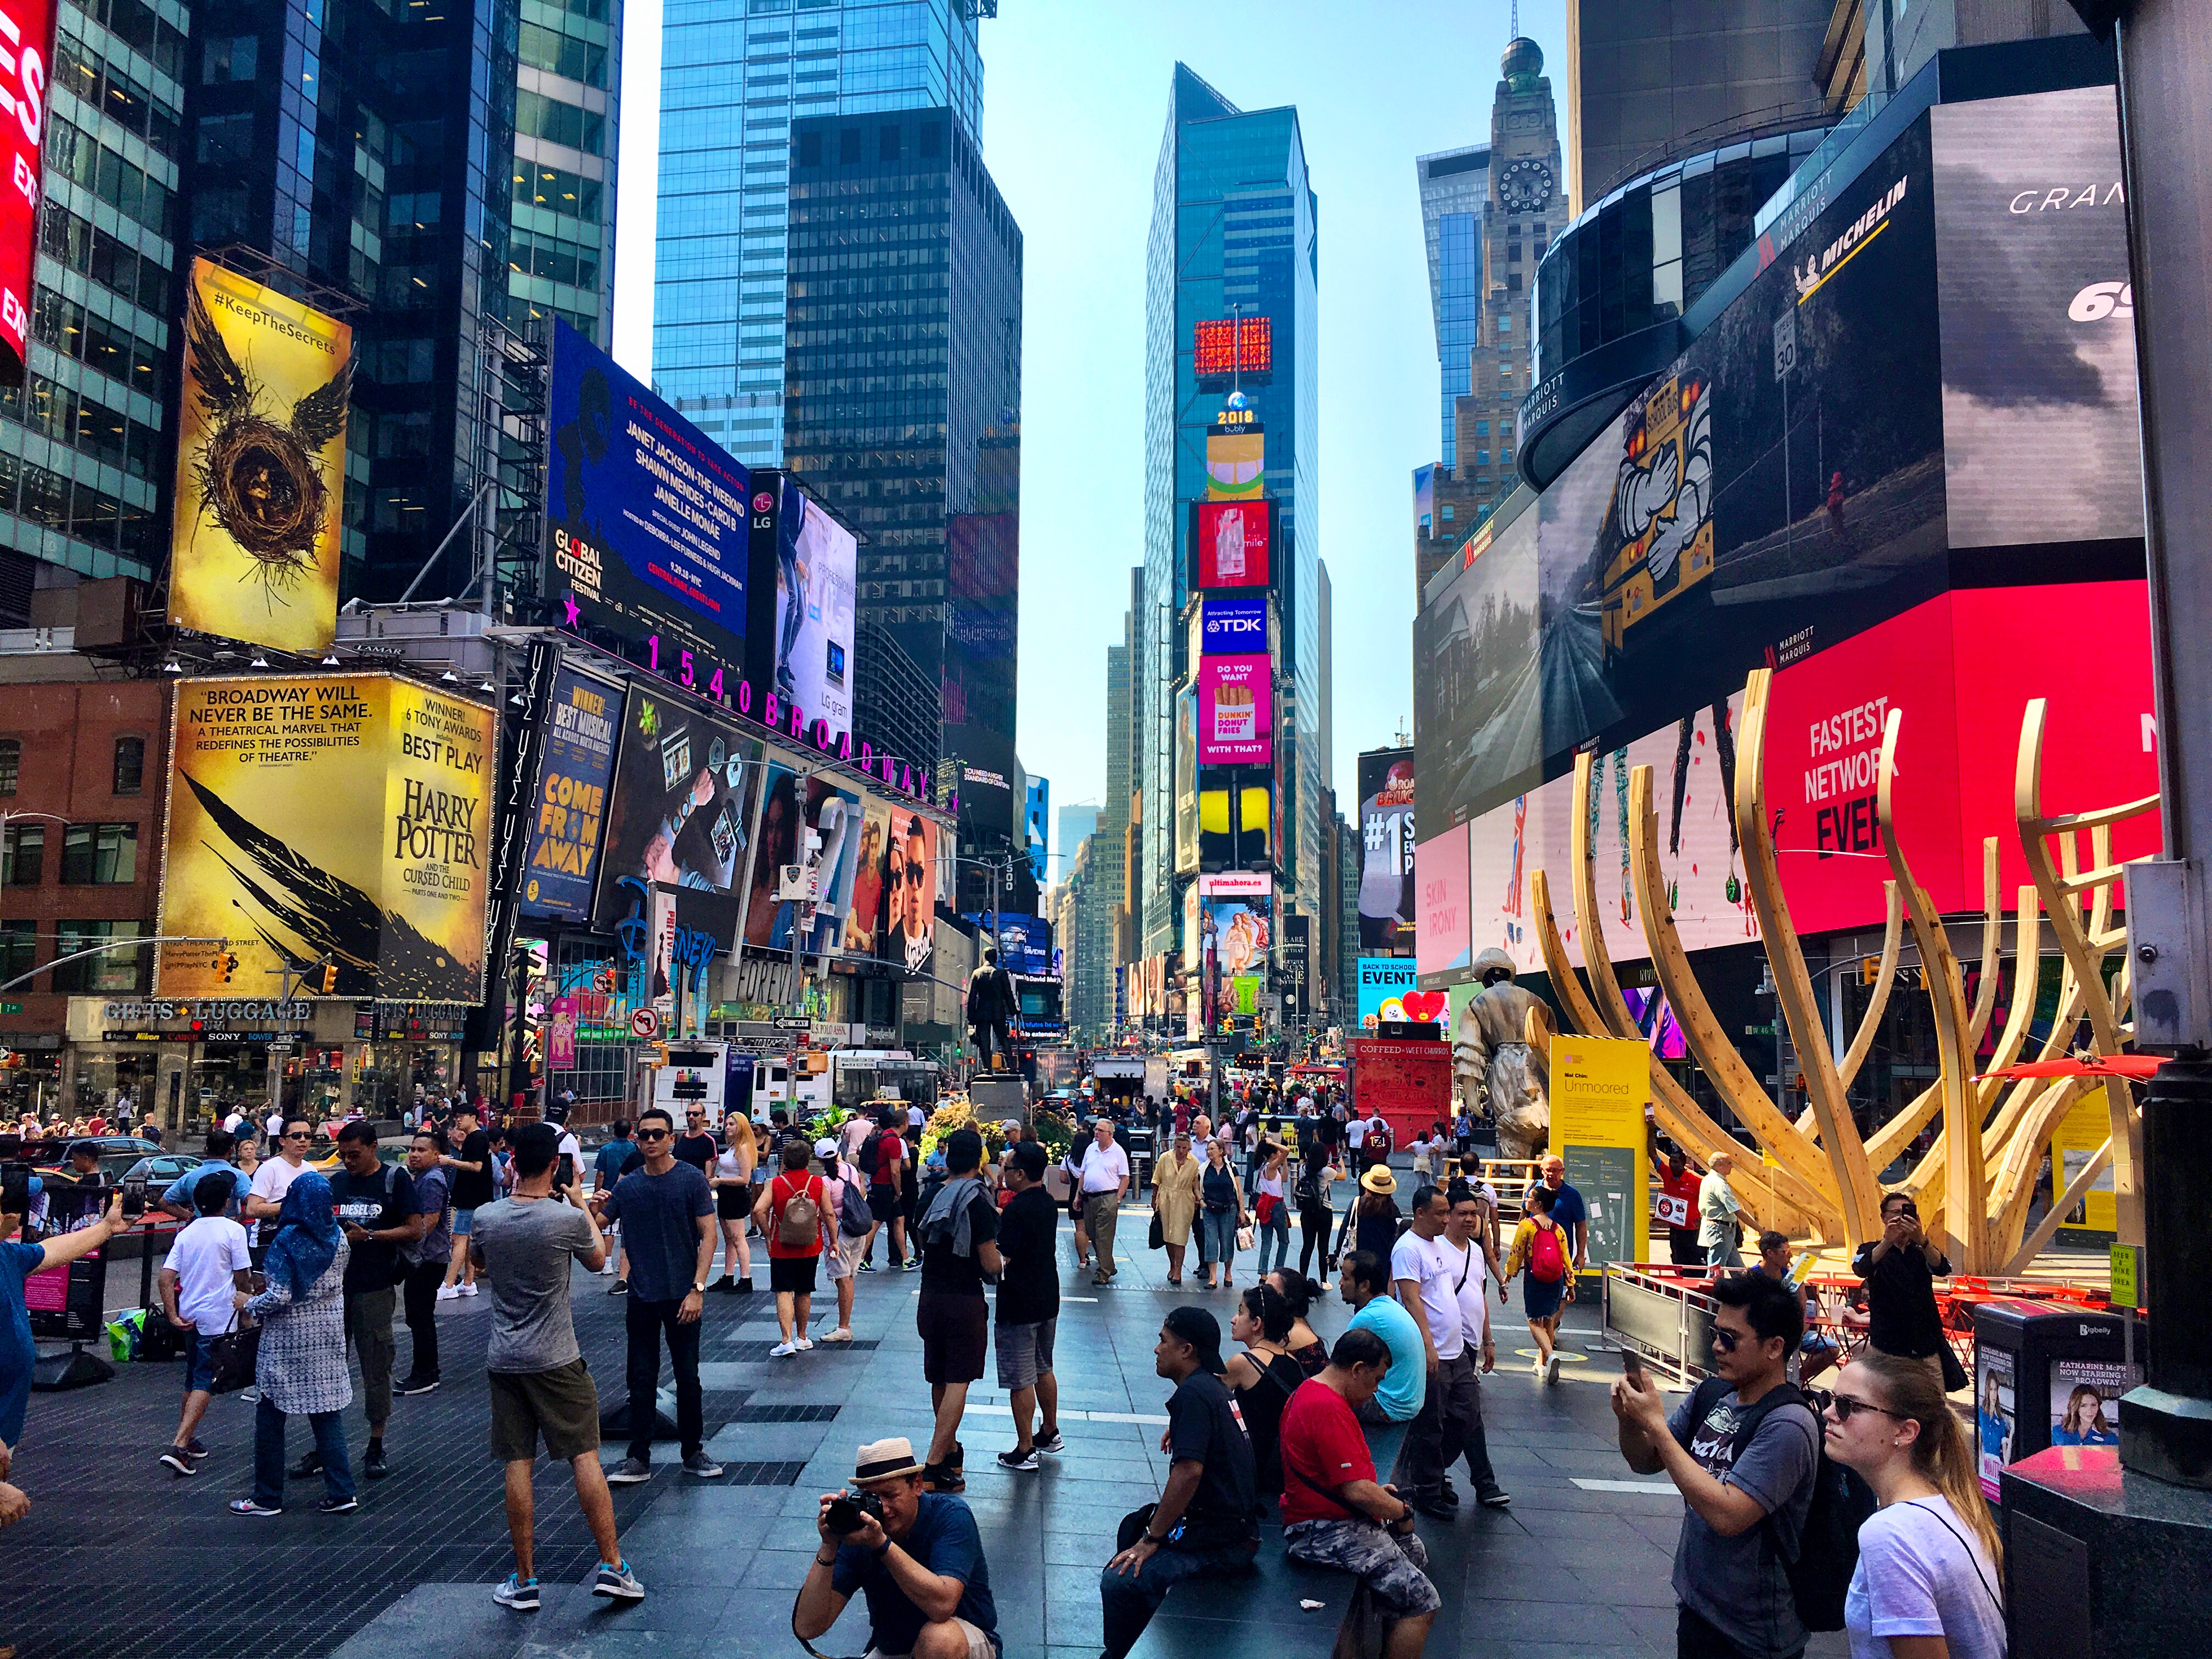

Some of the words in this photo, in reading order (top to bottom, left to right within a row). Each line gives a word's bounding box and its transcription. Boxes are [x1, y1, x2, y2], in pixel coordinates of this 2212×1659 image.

[1779, 169, 1833, 233] MARRIOTT
[1780, 196, 1827, 252] MARQUIS
[1821, 174, 1908, 273] MICHELIN
[215, 292, 336, 355] #KeepTheSecrets
[1778, 343, 1793, 374] 30
[1523, 372, 1564, 417] MARRIOTT
[1217, 410, 1253, 425] 2018
[1523, 394, 1558, 435] MARQUIS
[1647, 404, 1666, 435] SCHOOL
[627, 420, 655, 451] JANET
[713, 483, 745, 518] WEEKND
[636, 448, 669, 484] SHAWN
[670, 472, 704, 509] MENDES
[707, 501, 730, 528] CARDI
[731, 521, 736, 532] B
[654, 484, 691, 521] JANELLE
[691, 509, 720, 540] MONÁE
[753, 517, 771, 528] LG
[645, 521, 681, 551] DEBORRA-LEE
[681, 527, 698, 546] JOHN
[698, 538, 720, 561] LEGEND
[1473, 520, 1494, 546] MARRIOTT
[555, 529, 603, 571] GLOBAL
[1474, 534, 1492, 558] MARQUIS
[555, 550, 602, 590] CITIZEN
[571, 579, 601, 603] FESTIVAL
[1220, 618, 1261, 631] TDK
[1779, 625, 1815, 652] MARRIOTT
[1779, 641, 1811, 665] MARQUIS
[1222, 673, 1248, 681] WANT
[316, 686, 360, 701] WILL
[572, 685, 606, 716] WINNER!
[822, 692, 831, 708] LG
[832, 696, 848, 718] gram
[190, 708, 246, 723] NEVER
[252, 707, 273, 721] BE
[279, 705, 314, 721] THE
[319, 703, 373, 719] SAME.
[425, 698, 466, 722] WINNER!
[198, 727, 206, 736] A
[209, 725, 279, 736] THEATRICAL
[282, 723, 328, 735] MARVEL
[330, 722, 362, 733] THAT
[406, 709, 413, 720] 6
[414, 710, 442, 731] TONY
[443, 719, 482, 743] AWARDS
[552, 726, 562, 739] ALL
[555, 702, 579, 730] BEST
[578, 710, 612, 744] MUSICAL
[1218, 719, 1248, 727] DONUT
[1810, 696, 1889, 758] FASTEST
[196, 738, 256, 751] REDEFINES
[259, 738, 281, 749] THE
[284, 736, 360, 749] POSSIBILITIES
[403, 734, 442, 761] BEST
[445, 744, 483, 775] PLAY
[765, 691, 928, 799] BROADWAY
[1234, 744, 1262, 753] THAT?
[239, 752, 255, 763] OF
[975, 769, 987, 777] NEED
[403, 778, 479, 833] HARRY
[545, 772, 603, 816] COME
[538, 803, 600, 847] FROM
[394, 816, 481, 870] POTTER
[1364, 812, 1401, 876] #1
[532, 836, 595, 876] AWAY
[403, 868, 440, 888] CURSED
[442, 873, 471, 892] CHILD
[426, 864, 438, 873] AND
[439, 864, 450, 874] THE
[412, 888, 429, 898] PARTS
[1209, 878, 1261, 887] ultimahora.es
[1426, 878, 1447, 907] SKIN
[1430, 906, 1457, 937] IRONY
[1363, 971, 1416, 985] EVENT
[104, 1003, 173, 1020] GIFTS
[194, 1002, 310, 1020] LUGGAGE
[416, 1004, 467, 1021] LUGGAGE
[136, 1032, 160, 1041] Nikon
[820, 1024, 832, 1035] POLO
[1361, 1045, 1401, 1054] COFFEED
[1406, 1046, 1423, 1054] SWEET
[1424, 1046, 1449, 1056] CHURROS
[1564, 1079, 1629, 1095] Unmoored
[340, 1204, 369, 1216] DIESEL
[2113, 1251, 2129, 1260] BEER
[2114, 1266, 2130, 1275] WINE
[2114, 1277, 2130, 1286] AREA
[2080, 1324, 2111, 1336] Bigbelly
[2059, 1361, 2104, 1370] KATHARINE
[2082, 1370, 2121, 1379] STARRING
[2075, 1378, 2120, 1386] BROADWAY
